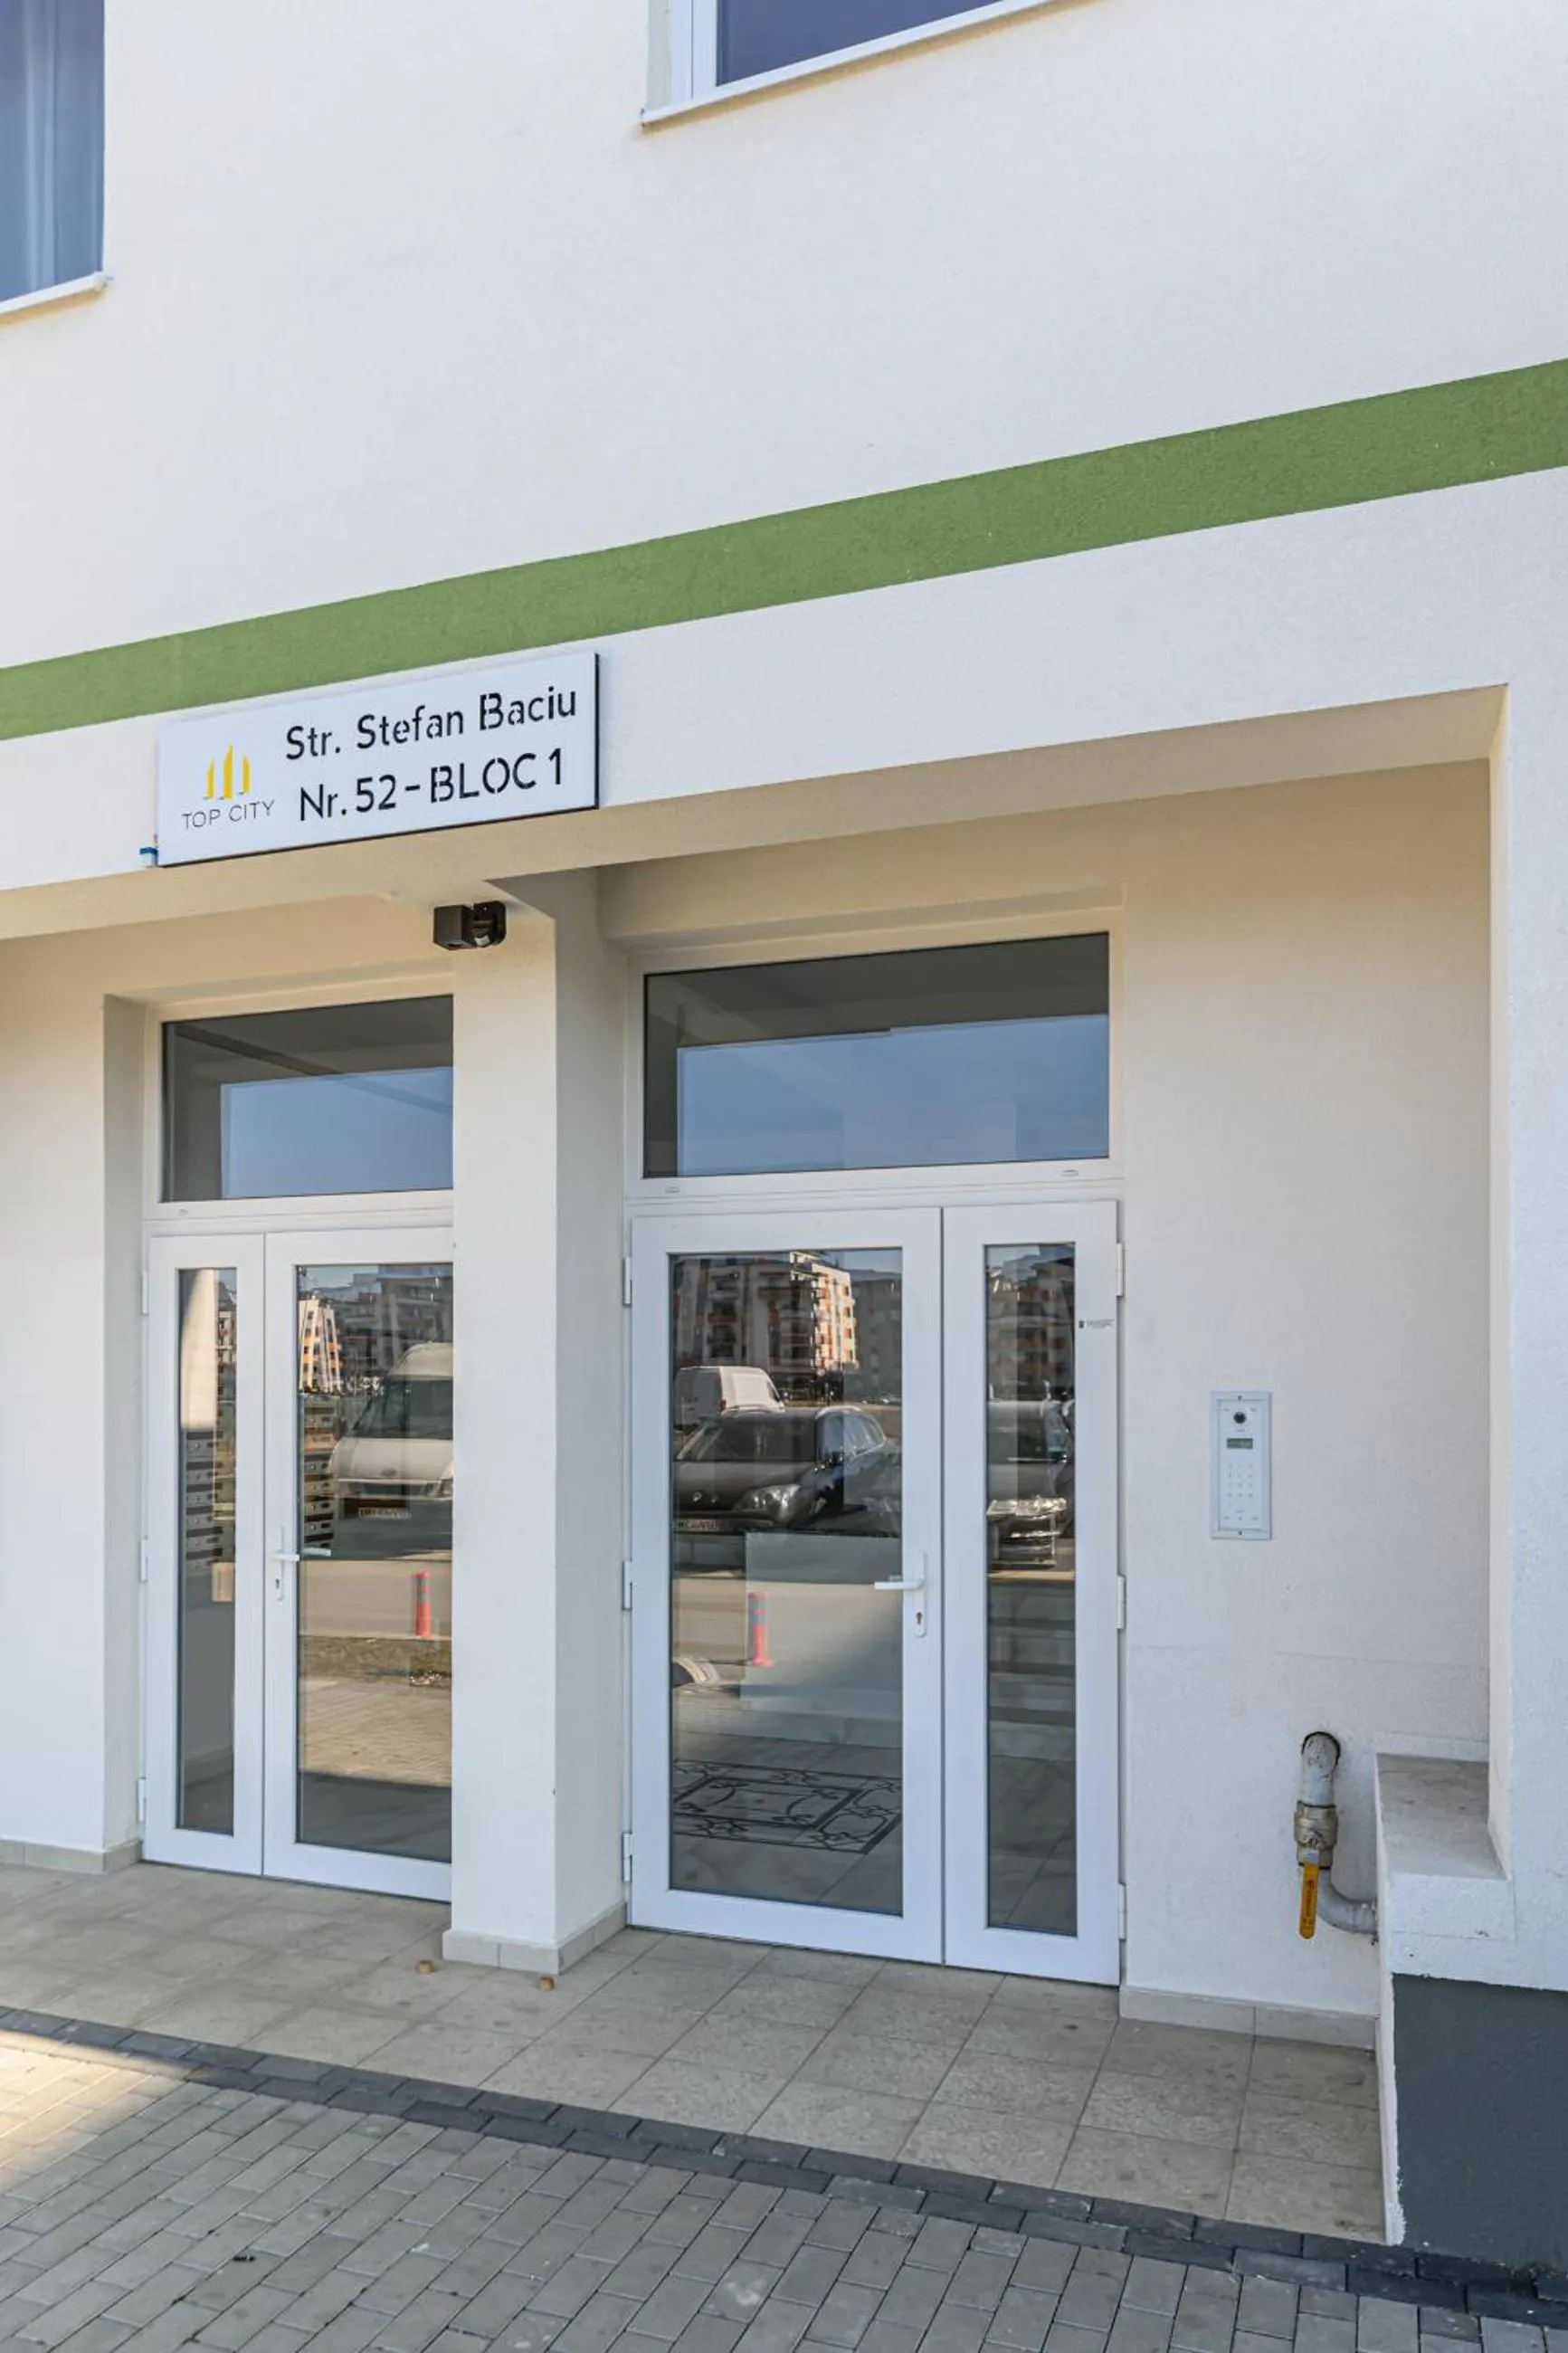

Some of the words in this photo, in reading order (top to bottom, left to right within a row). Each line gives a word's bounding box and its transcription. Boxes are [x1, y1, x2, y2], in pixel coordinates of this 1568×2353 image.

[285, 725, 341, 761] Str.
[356, 704, 464, 750] Stefan
[479, 685, 576, 731] Baciu
[181, 808, 221, 829] TOP
[228, 799, 275, 823] CITY
